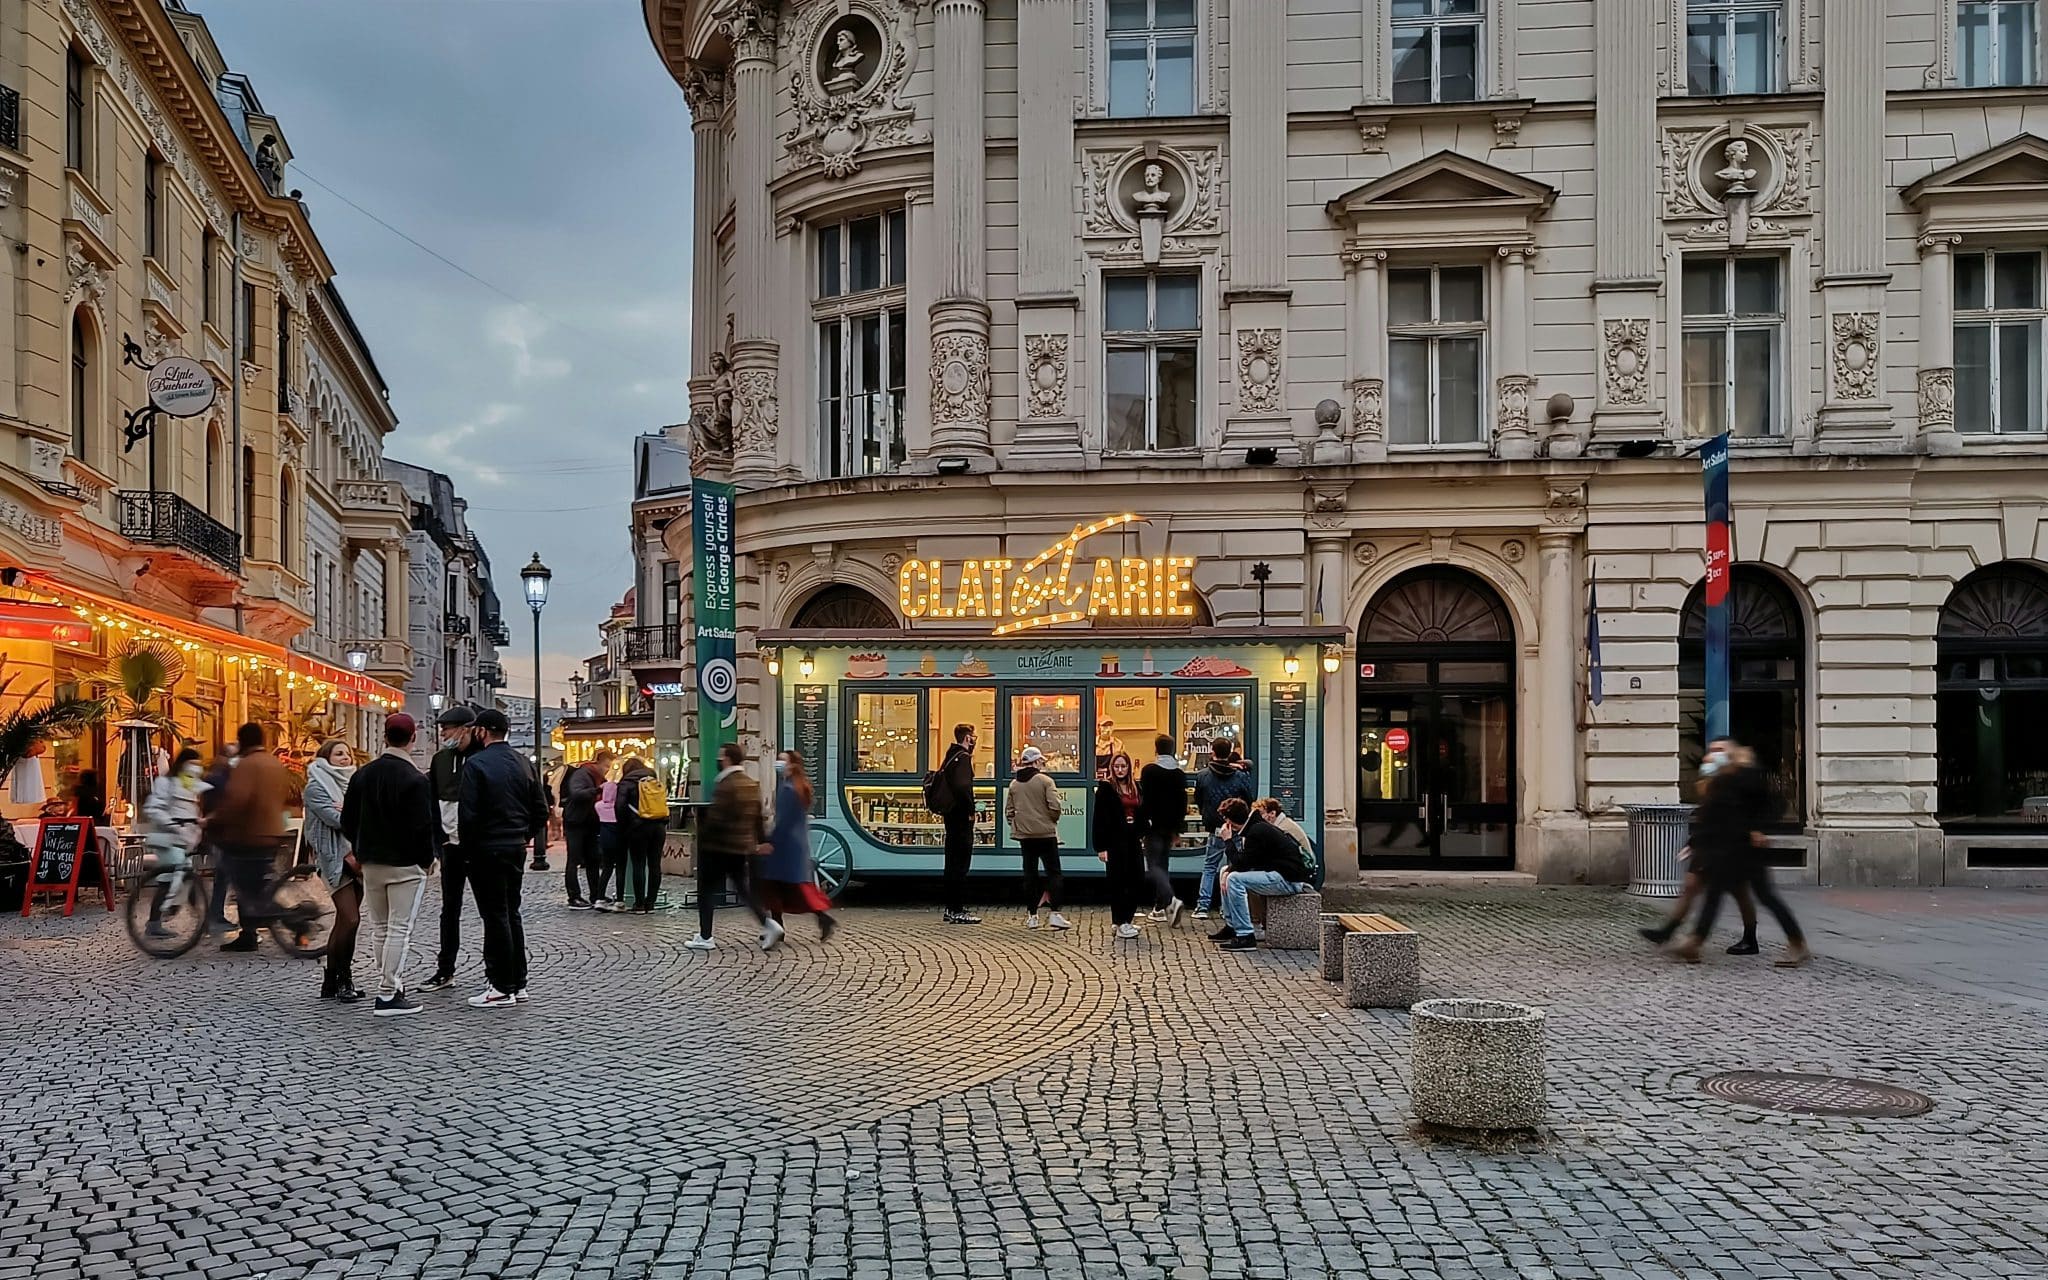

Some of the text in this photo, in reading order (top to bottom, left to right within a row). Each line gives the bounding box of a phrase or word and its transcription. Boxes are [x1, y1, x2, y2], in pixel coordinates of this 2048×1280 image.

[165, 366, 194, 381] Little
[150, 378, 204, 392] Bucharest
[702, 494, 718, 609] Express yourself
[716, 496, 730, 610] in George Circles
[698, 625, 736, 639] Art Safar
